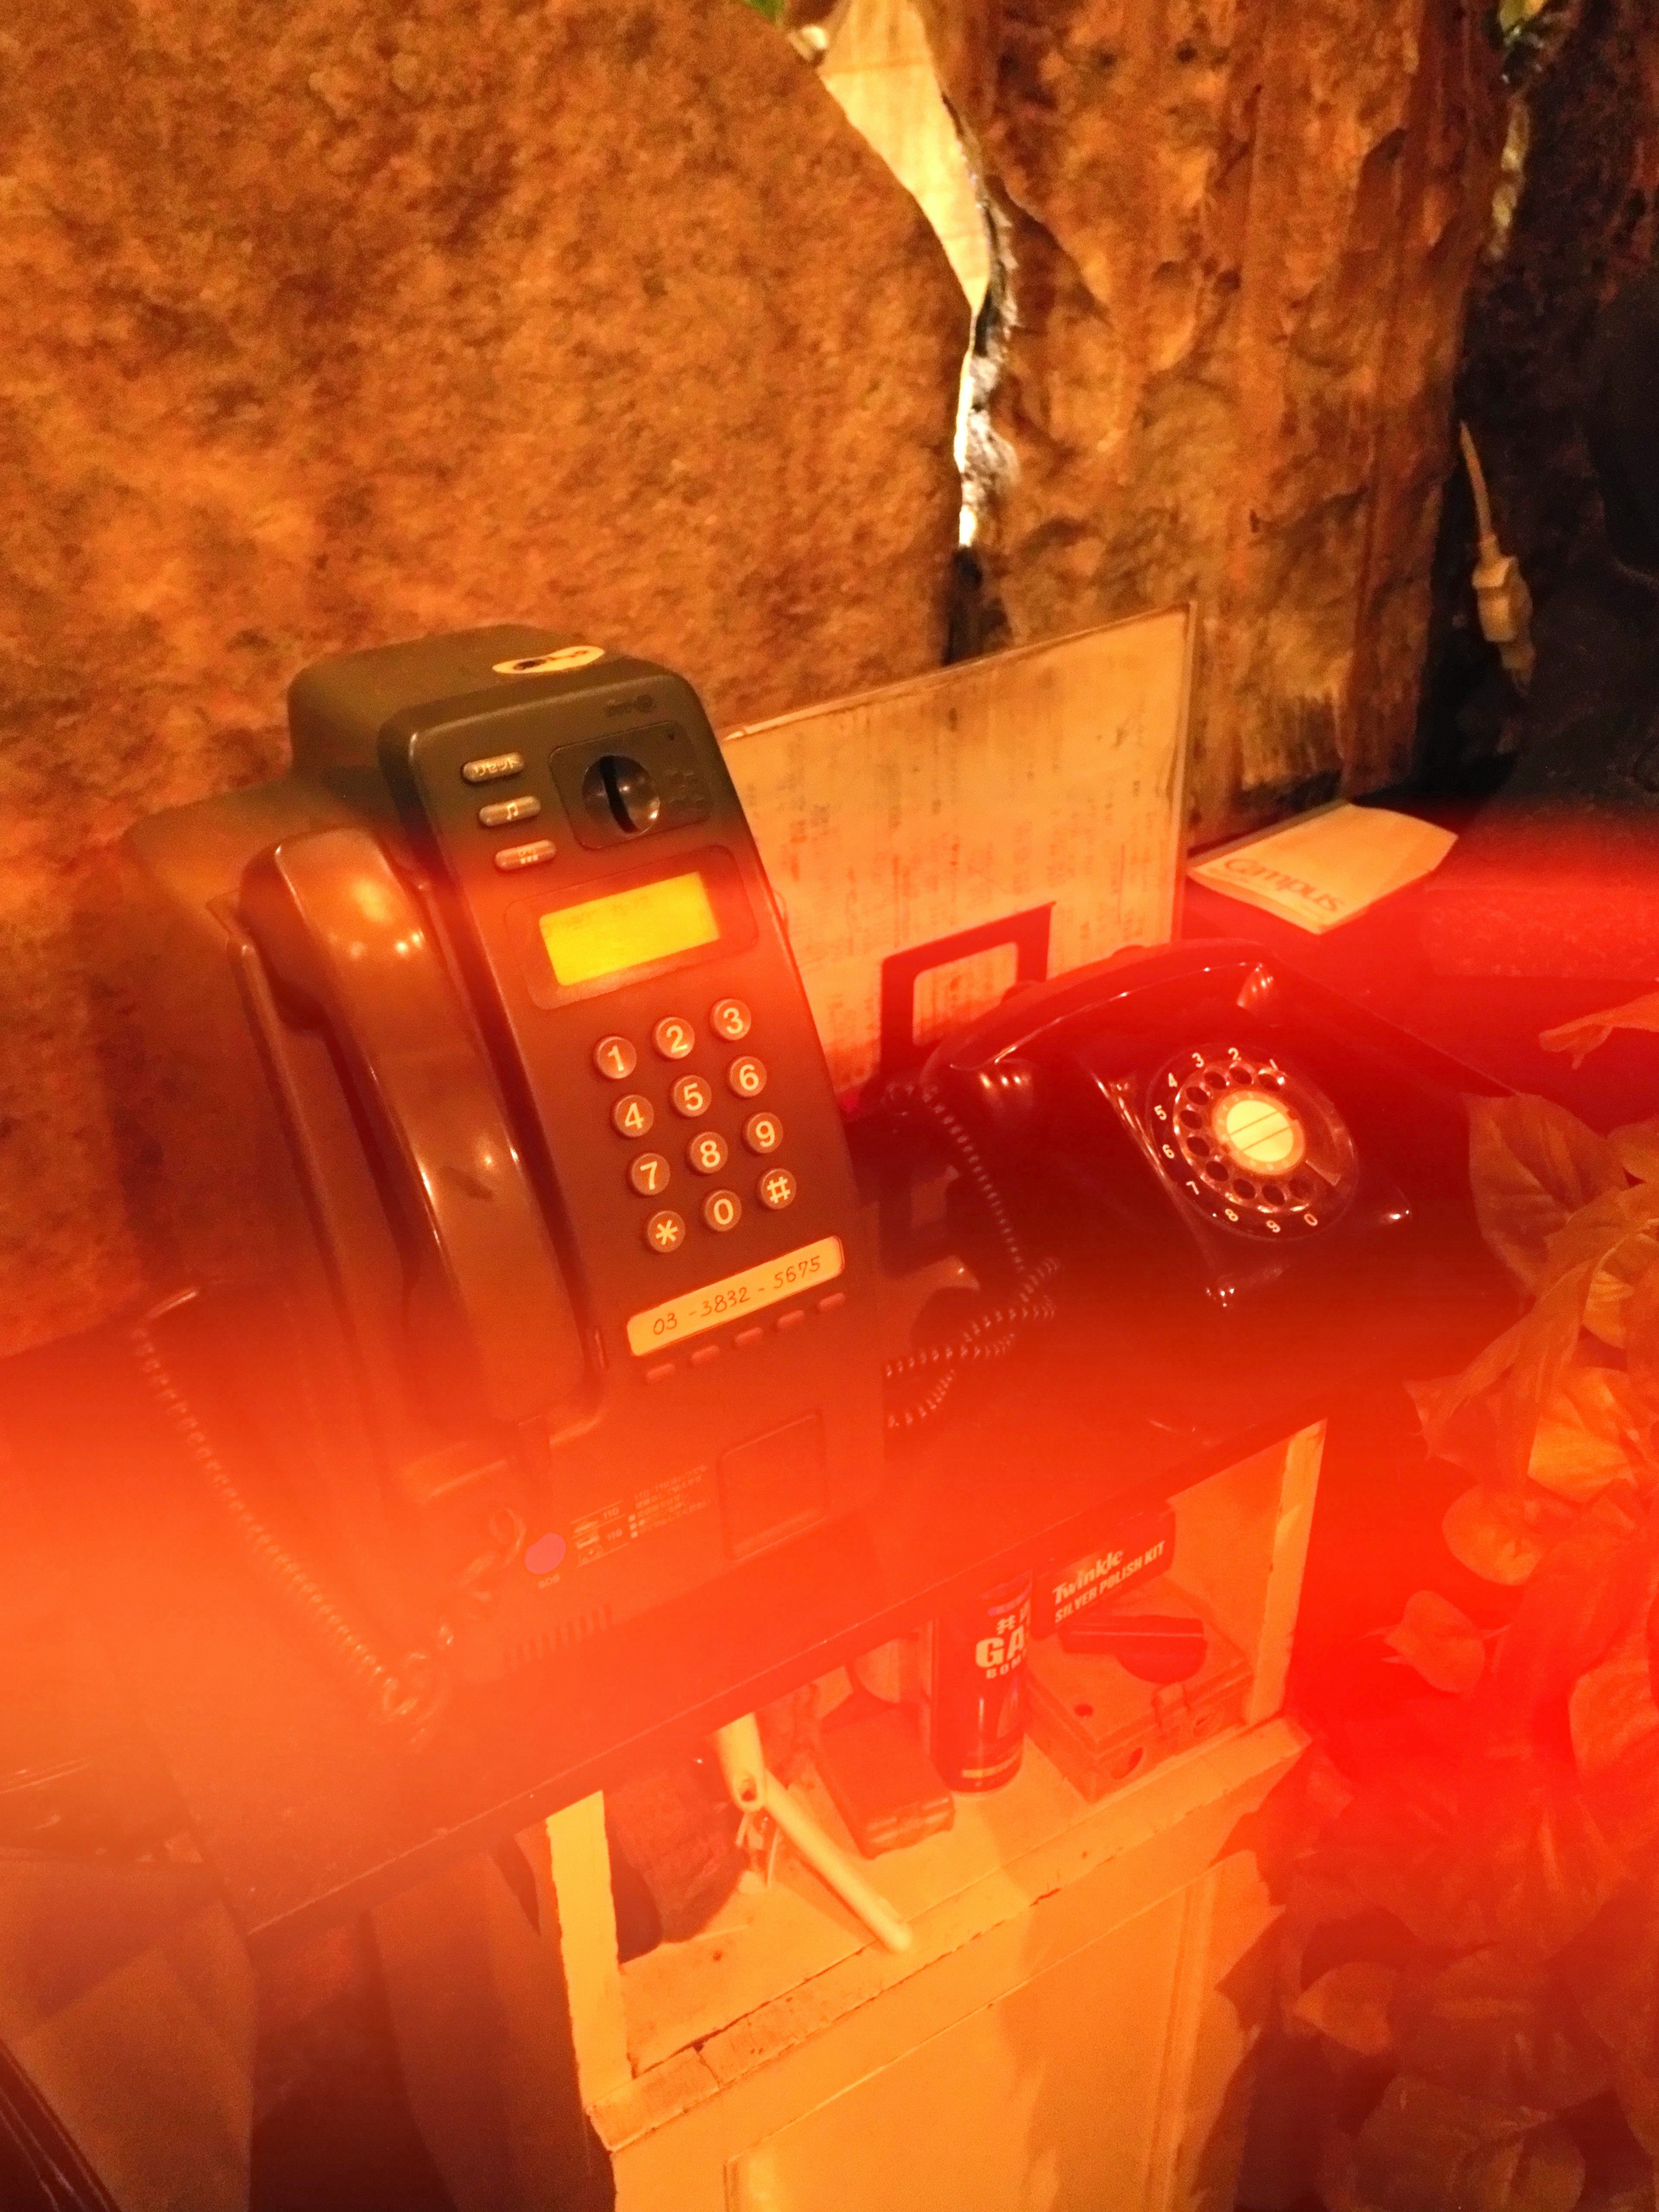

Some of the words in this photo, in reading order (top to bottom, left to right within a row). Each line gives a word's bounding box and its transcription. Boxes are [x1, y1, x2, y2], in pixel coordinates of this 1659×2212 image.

[608, 1045, 624, 1071] 1
[666, 1025, 689, 1054] 2
[724, 1008, 744, 1034] 3
[1192, 1052, 1204, 1068] 3
[1228, 1047, 1242, 1061] 2
[1168, 1073, 1177, 1087] 4
[624, 1103, 644, 1129] 4
[684, 1083, 703, 1111] 5
[739, 1064, 759, 1091] 6
[1154, 1105, 1167, 1120] 5
[640, 1161, 657, 1190] 7
[700, 1140, 720, 1168] 8
[755, 1121, 775, 1147] 9
[1162, 1144, 1175, 1159] 6
[1186, 1181, 1199, 1195] 7
[714, 1199, 734, 1225] 0
[1225, 1208, 1238, 1222] 8
[1266, 1220, 1281, 1233] 9
[1303, 1213, 1318, 1227] 0
[1052, 1549, 1124, 1606] Twinkle
[1054, 1586, 1097, 1624] SILVER
[1099, 1555, 1143, 1595] POLISH
[1145, 1539, 1166, 1565] KIT
